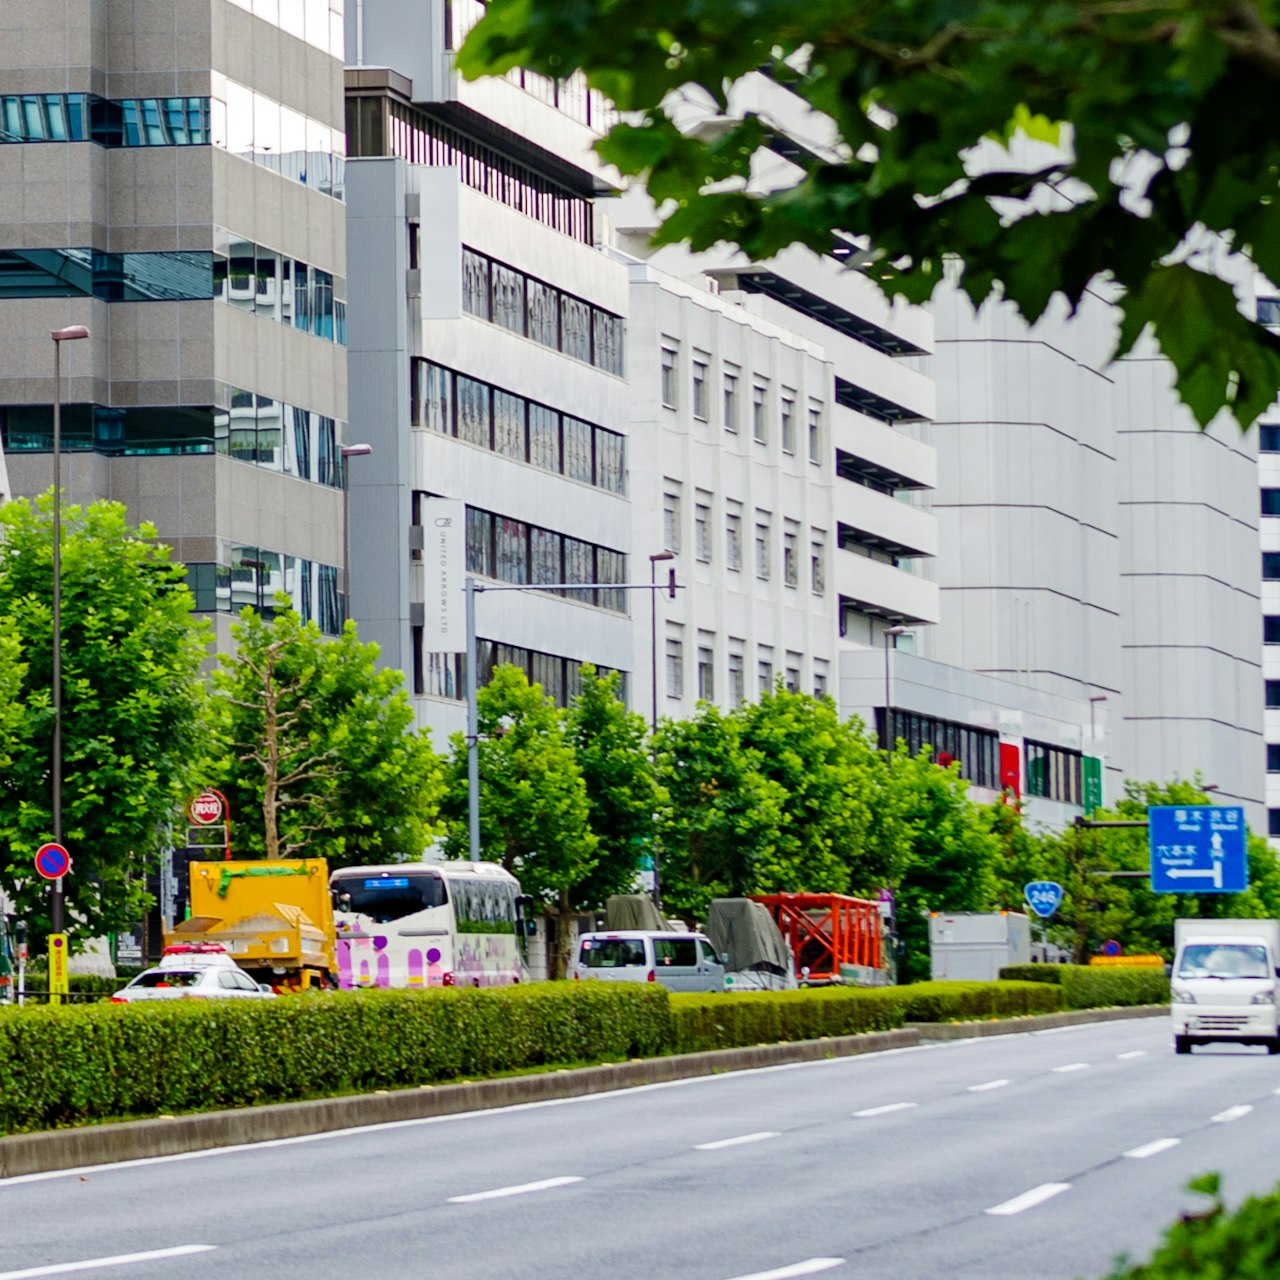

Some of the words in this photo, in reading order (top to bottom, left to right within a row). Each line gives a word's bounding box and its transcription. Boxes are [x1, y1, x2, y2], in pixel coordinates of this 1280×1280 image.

[195, 802, 218, 814] 消火栓
[1210, 809, 1239, 823] 渋谷
[1156, 845, 1198, 858] 六本木
[1031, 890, 1057, 904] 246
